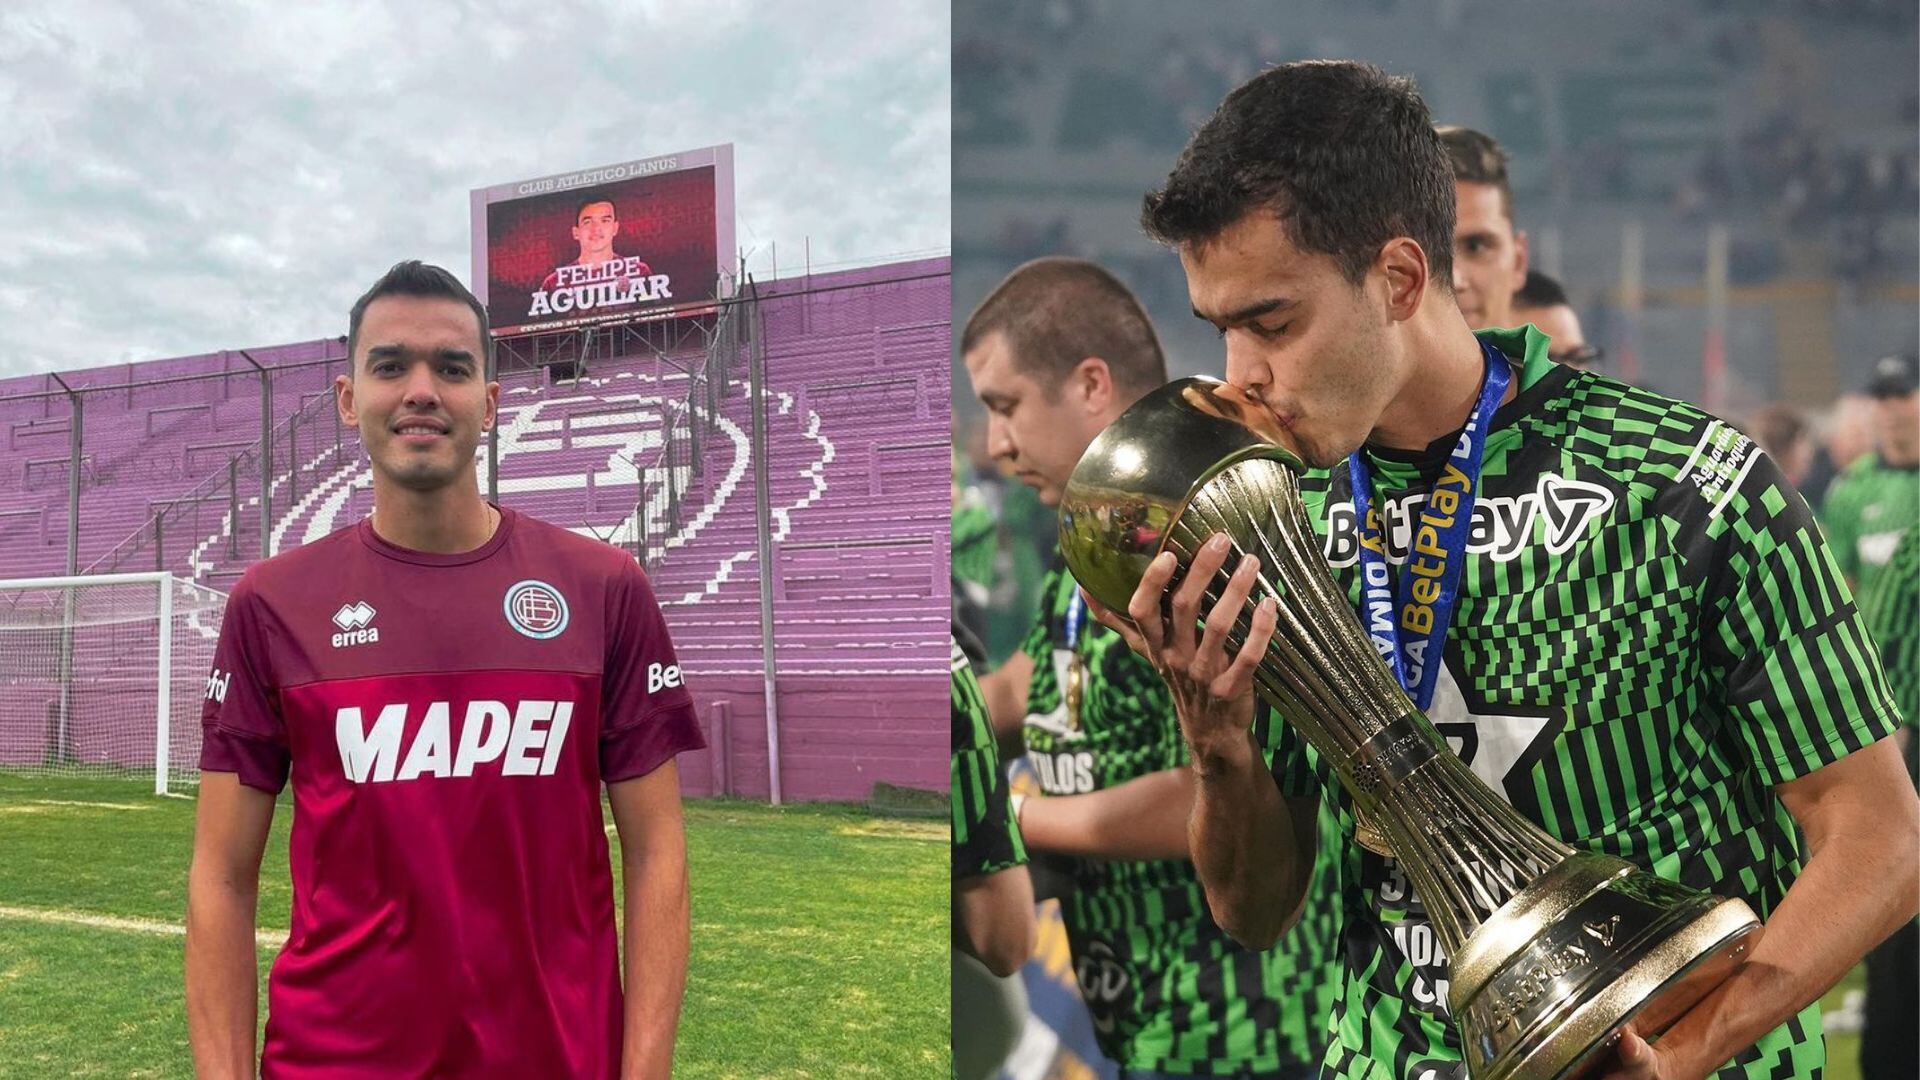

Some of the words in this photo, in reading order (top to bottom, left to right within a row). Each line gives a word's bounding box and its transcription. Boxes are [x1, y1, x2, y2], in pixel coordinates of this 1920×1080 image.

[518, 180, 556, 195] CLUB
[557, 166, 627, 189] ATLETICO
[629, 157, 678, 177] LANUS
[555, 256, 640, 287] FELIPE
[528, 274, 673, 316] AGUILAR
[1401, 462, 1472, 635] BetPlay
[335, 700, 575, 784] MAPEI
